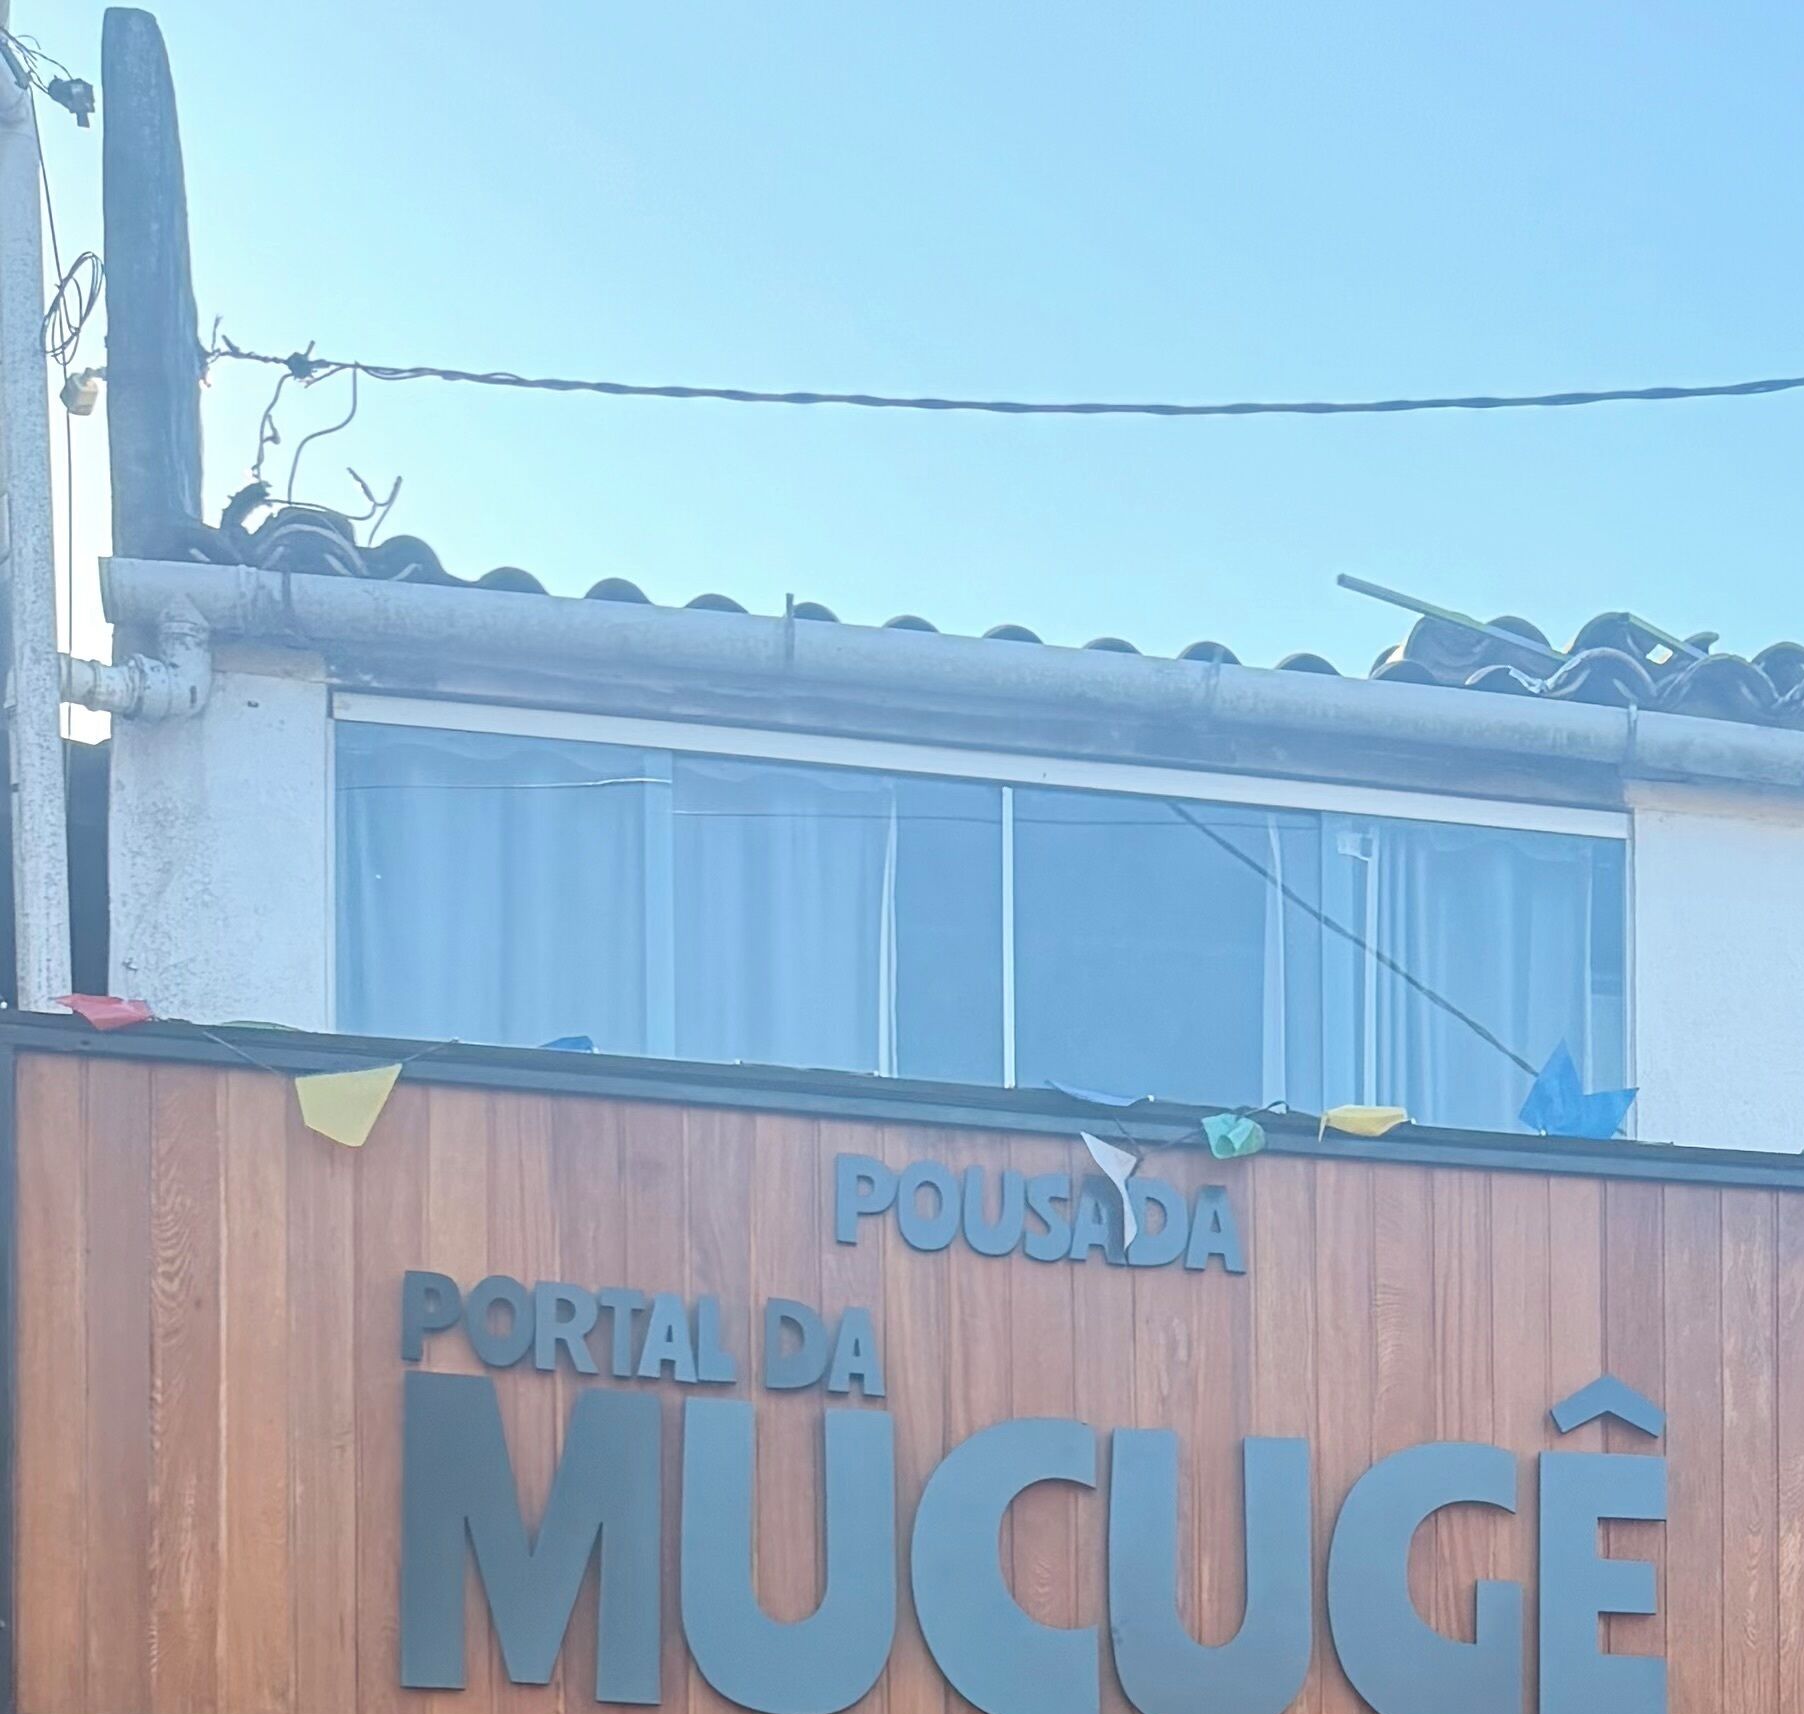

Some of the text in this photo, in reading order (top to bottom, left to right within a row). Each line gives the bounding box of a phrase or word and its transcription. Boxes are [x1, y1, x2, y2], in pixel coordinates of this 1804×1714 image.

[836, 1152, 1247, 1274] POUSADA
[401, 1270, 886, 1398] PORTAL DA
